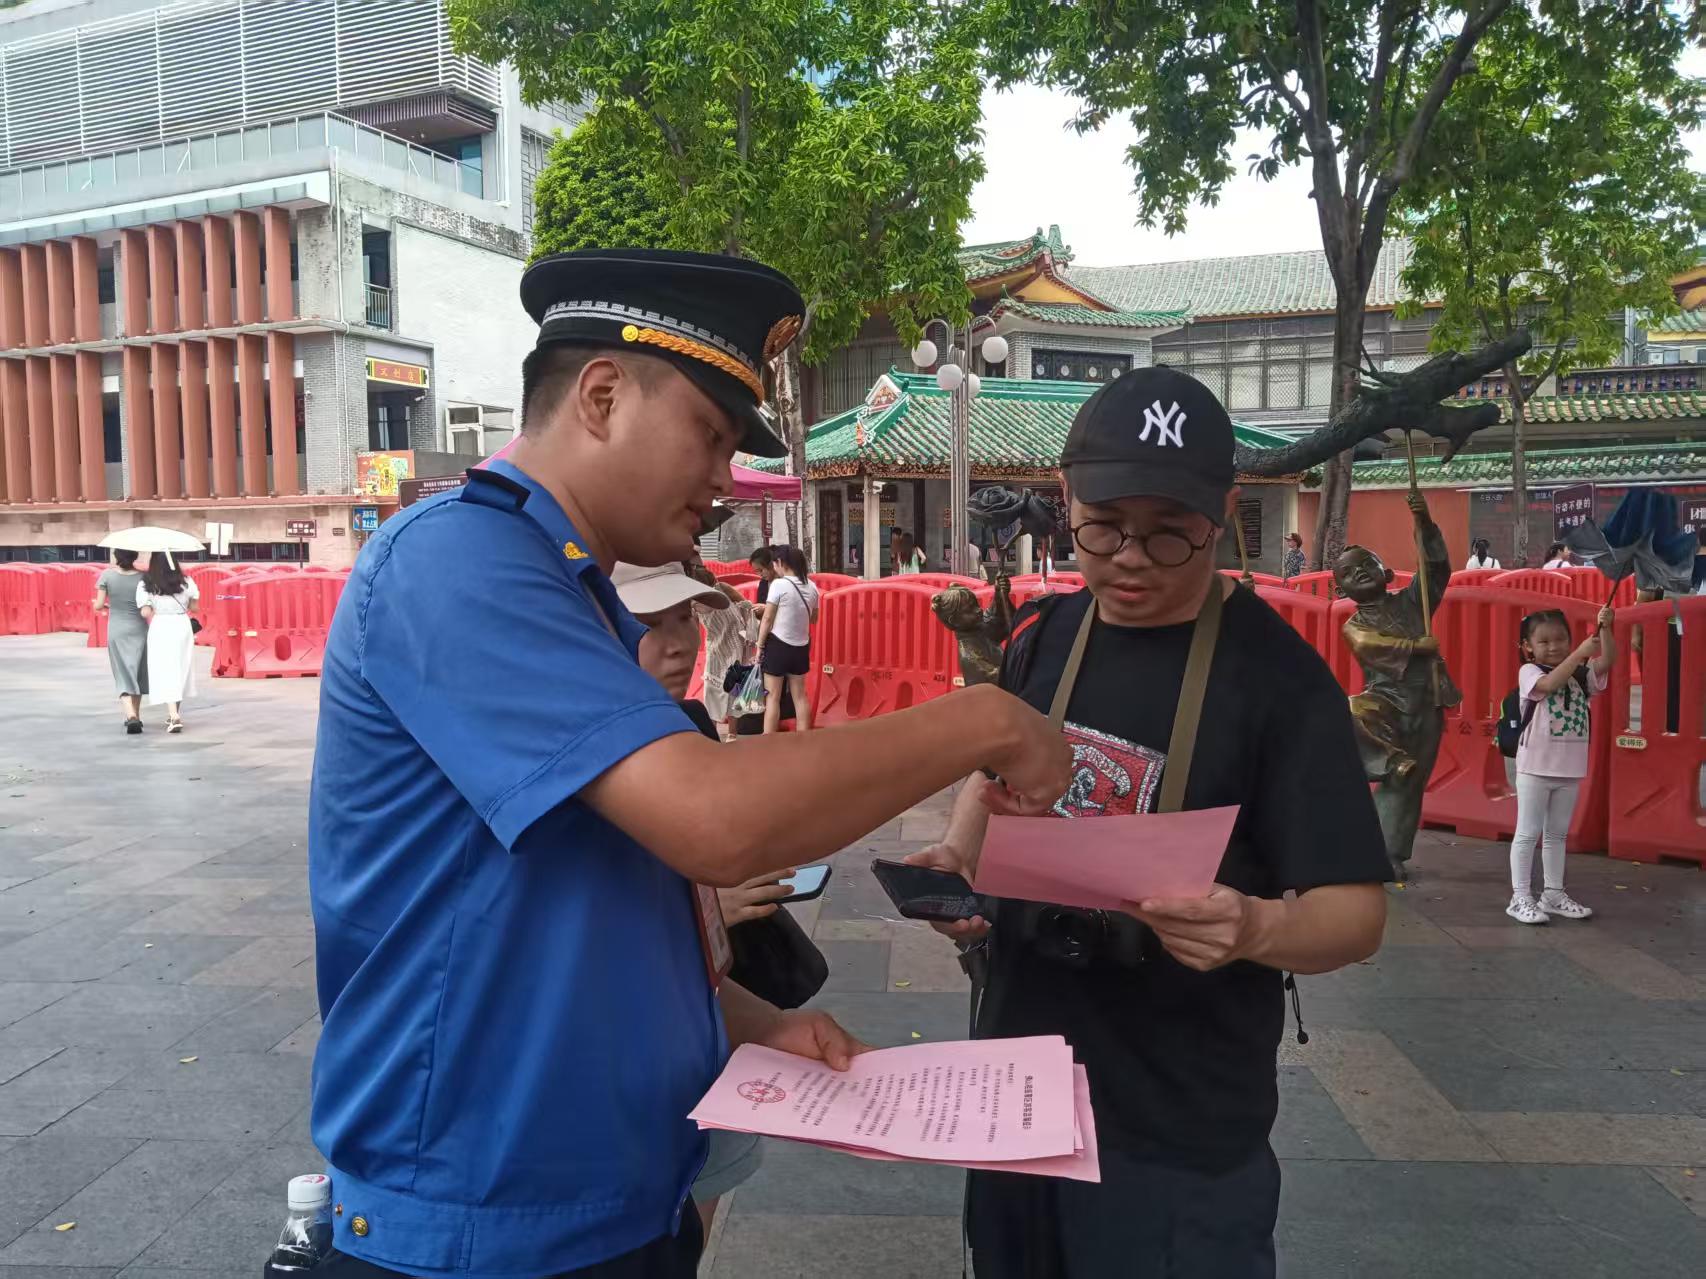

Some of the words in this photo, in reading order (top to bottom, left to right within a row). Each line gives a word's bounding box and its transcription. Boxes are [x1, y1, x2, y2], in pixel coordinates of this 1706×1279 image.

[1139, 400, 1187, 448] NY
[1555, 497, 1591, 514] 行动不便的
